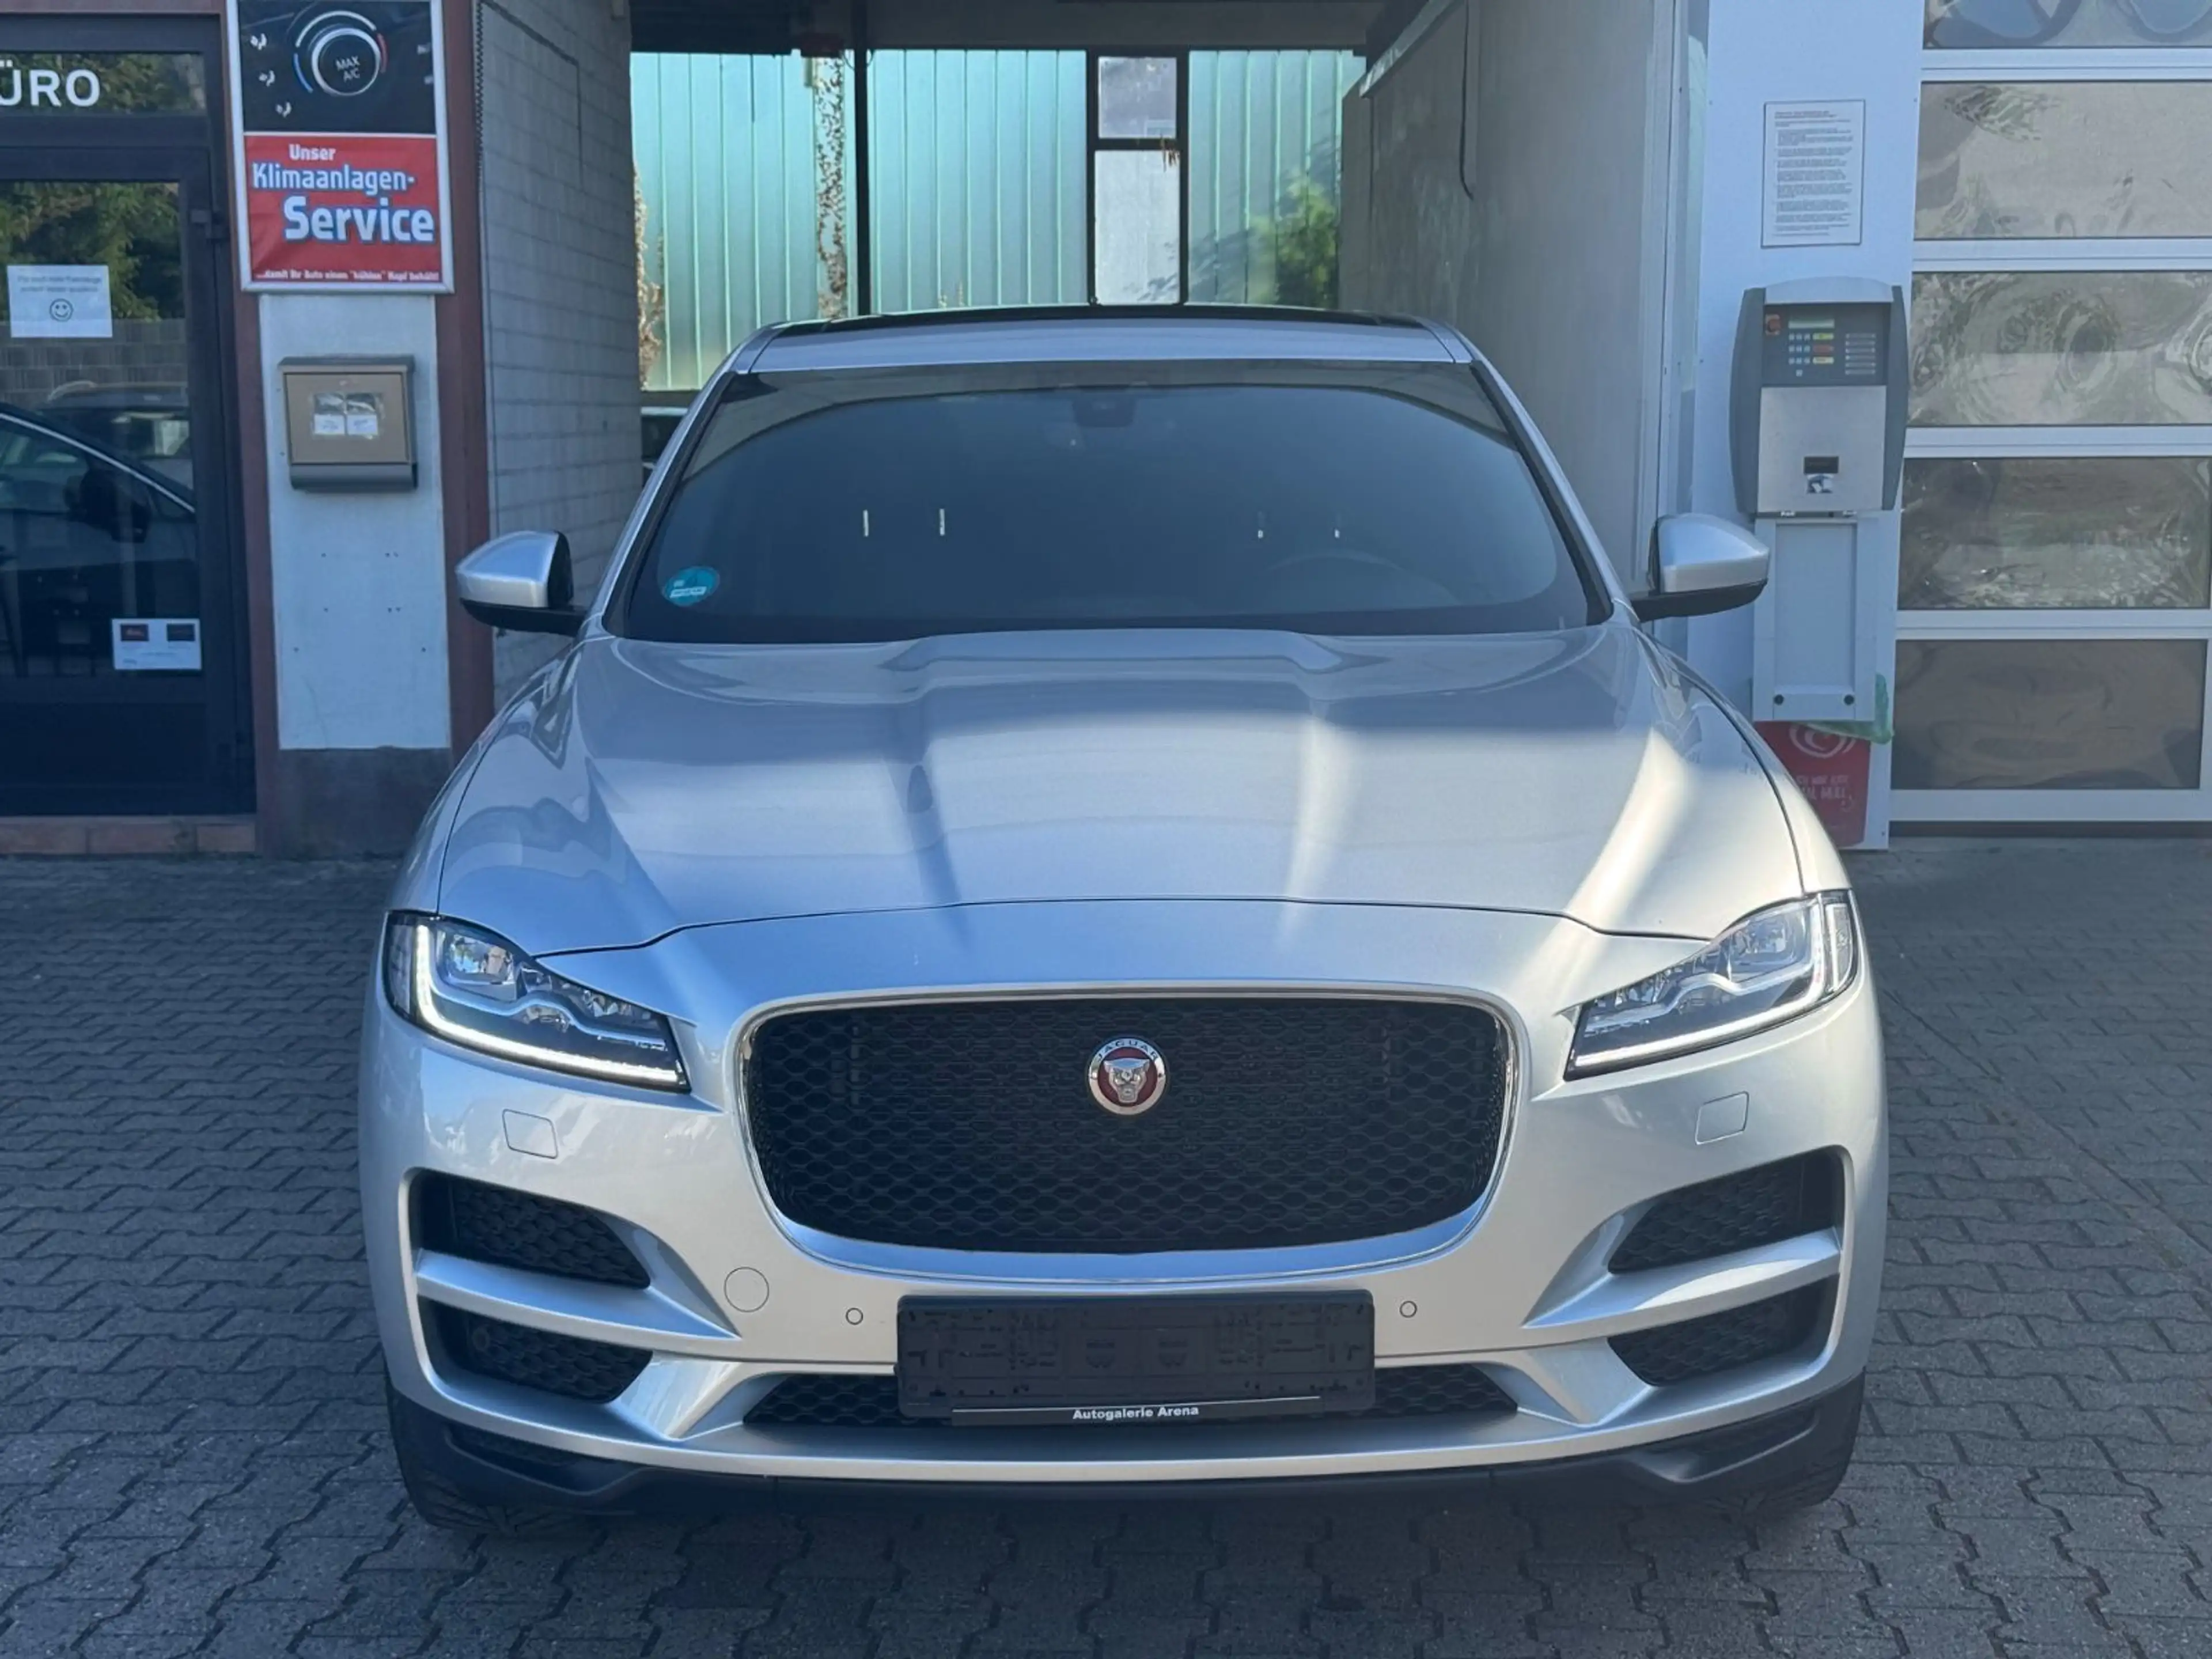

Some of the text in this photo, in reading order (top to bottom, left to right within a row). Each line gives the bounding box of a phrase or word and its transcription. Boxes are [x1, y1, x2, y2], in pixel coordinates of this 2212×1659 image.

[336, 56, 360, 71] MAX
[289, 144, 336, 160] Unser
[252, 163, 415, 196] Klimaanlagen-
[283, 196, 435, 241] Service
[1097, 1039, 1159, 1062] JAGUAR
[1073, 1406, 1199, 1421] Autogalerie Arena
